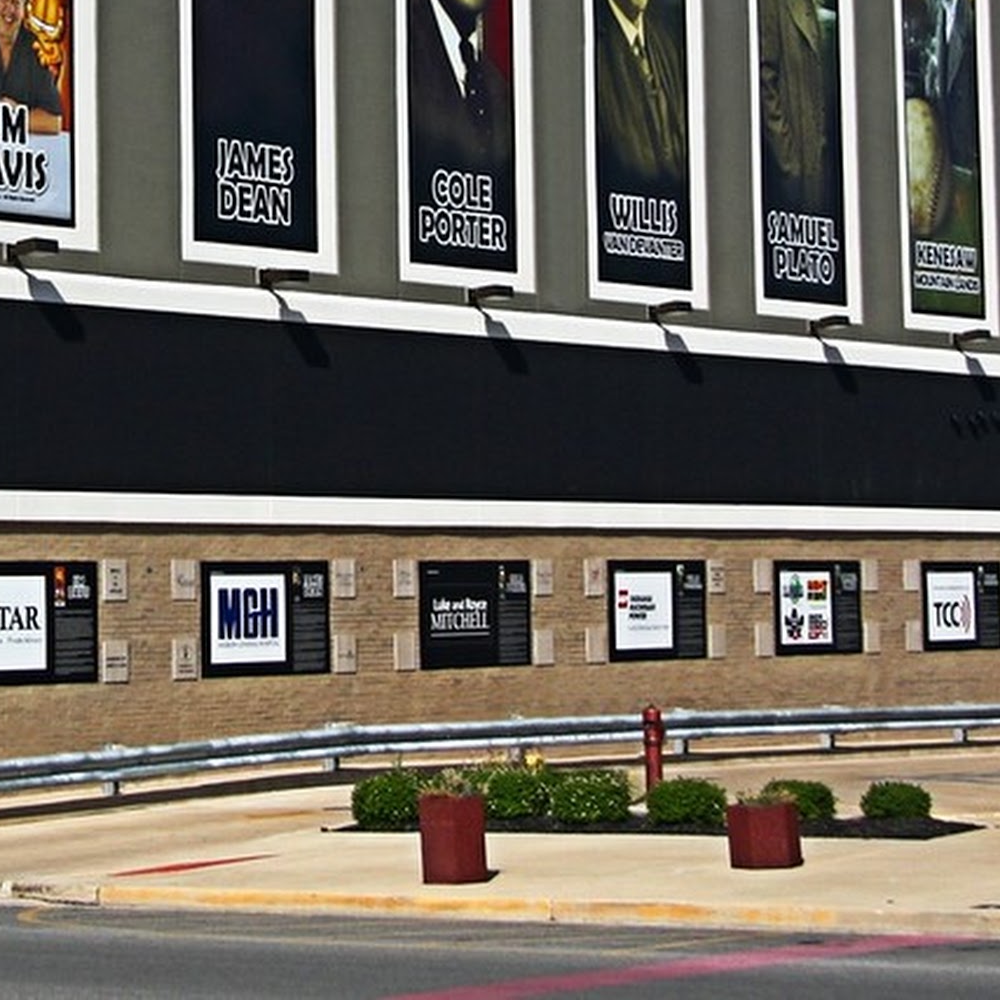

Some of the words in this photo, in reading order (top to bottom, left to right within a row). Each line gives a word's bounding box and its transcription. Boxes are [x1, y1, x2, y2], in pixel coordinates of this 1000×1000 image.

[216, 138, 294, 185] JAMES
[218, 180, 291, 226] DEAN
[432, 169, 492, 211] COLE
[419, 206, 506, 251] PORTER
[609, 192, 677, 237] WILLIS
[767, 210, 839, 252] SAMUEL
[773, 246, 835, 285] PLATO
[915, 241, 977, 272] KENESAW
[218, 587, 279, 640] MGH
[430, 611, 490, 630] MITCHELL
[933, 601, 961, 627] TCC
